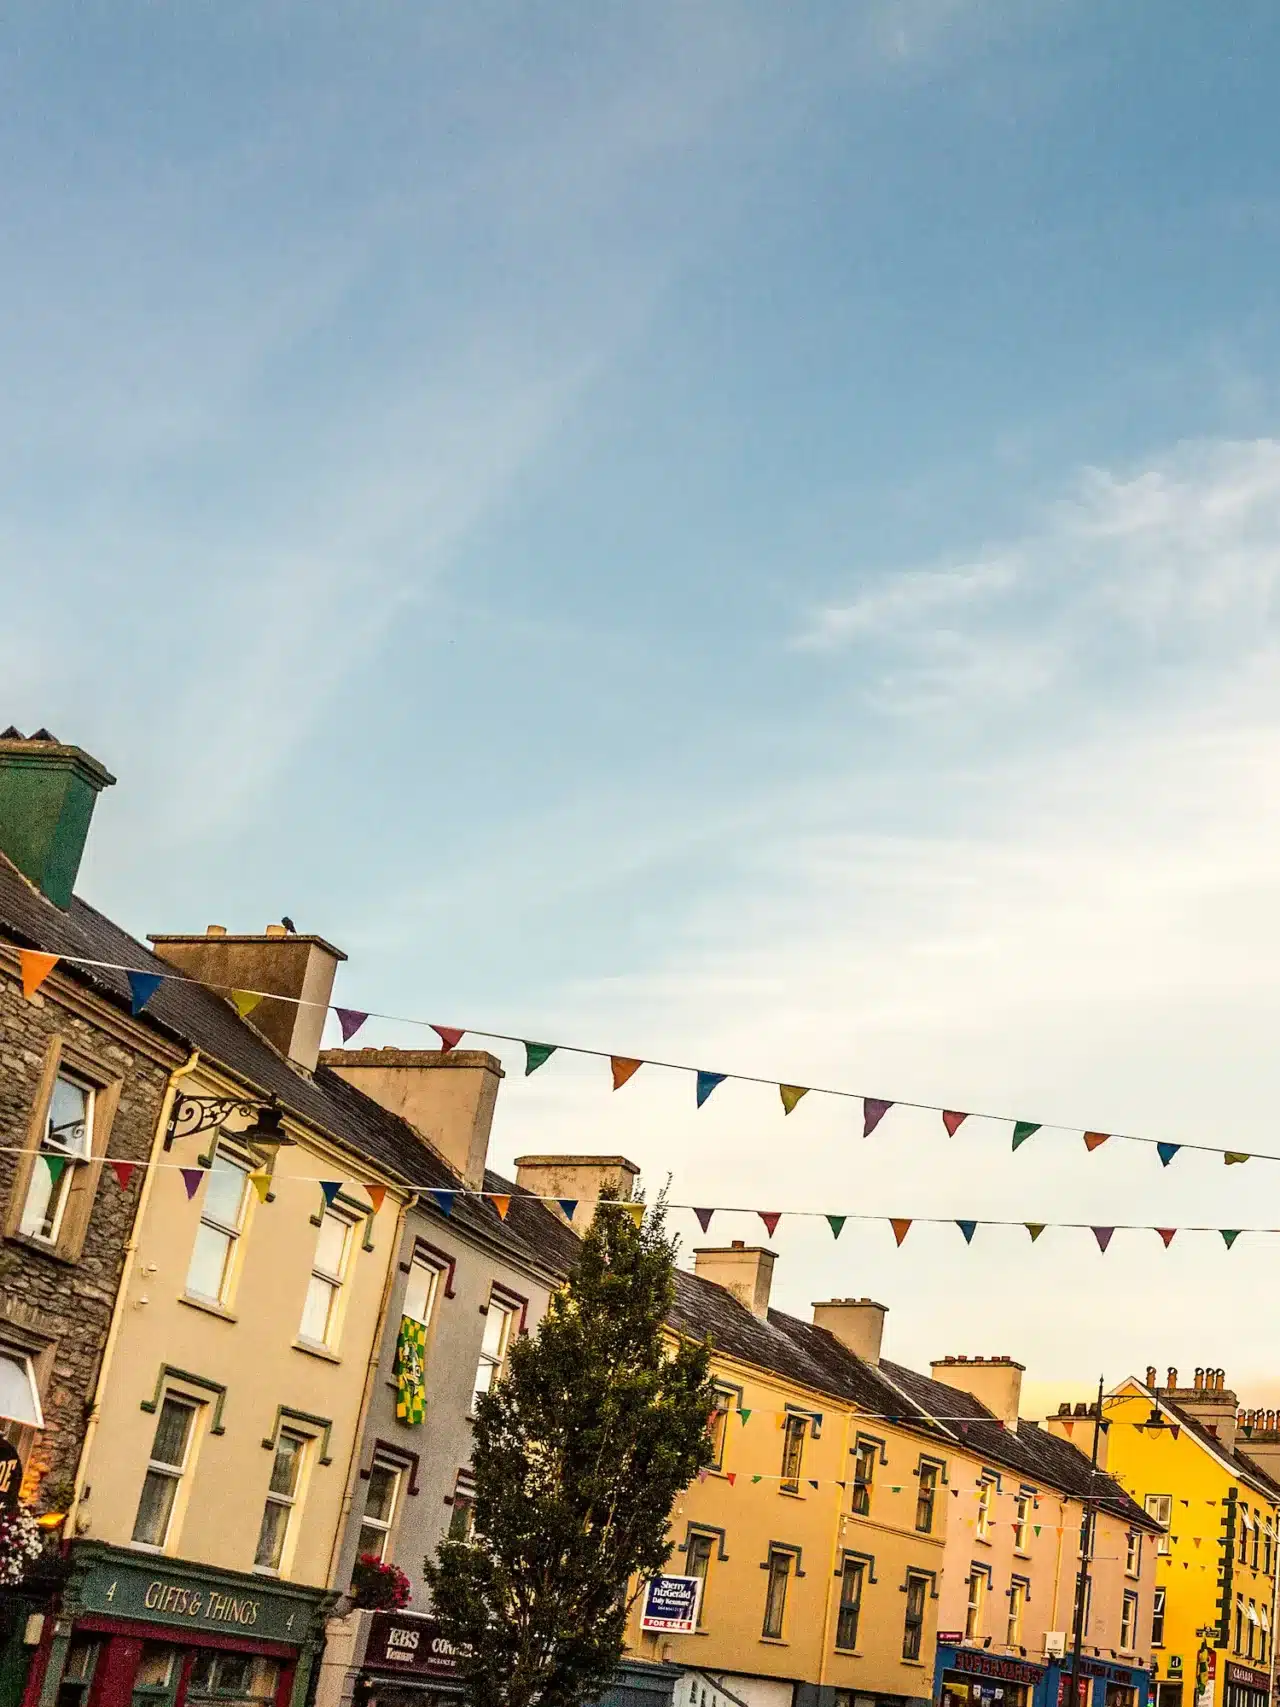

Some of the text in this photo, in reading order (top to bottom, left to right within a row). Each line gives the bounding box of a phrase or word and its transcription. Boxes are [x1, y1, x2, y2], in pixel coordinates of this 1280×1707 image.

[660, 1580, 685, 1591] Sherry
[105, 1581, 296, 1631] 4 GIFTS & THINGS 4
[648, 1619, 688, 1629] FOR SALE
[387, 1627, 420, 1650] EBS
